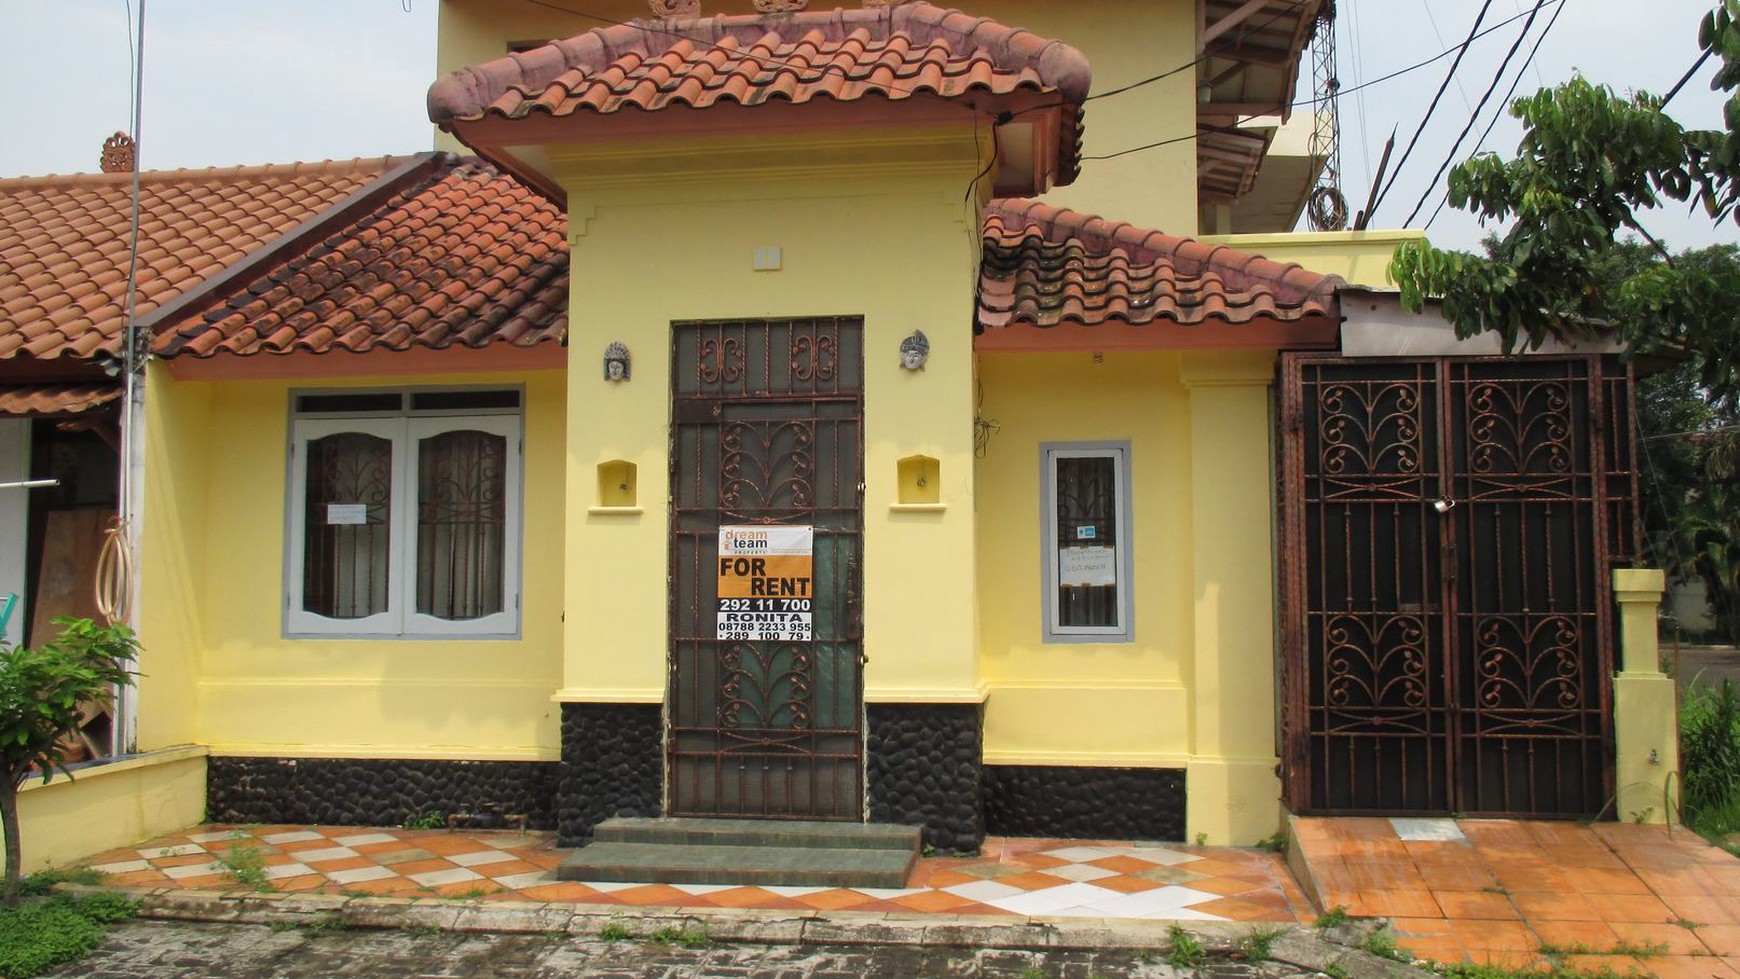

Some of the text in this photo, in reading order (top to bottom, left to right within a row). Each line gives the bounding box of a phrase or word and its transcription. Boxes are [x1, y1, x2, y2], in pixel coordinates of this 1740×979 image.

[726, 529, 768, 540] dream
[734, 538, 768, 548] team
[721, 558, 766, 576] FOR
[752, 577, 810, 596] RENT
[720, 599, 811, 611] 292 11 700
[726, 613, 803, 622] RONITA
[719, 622, 811, 631] 08788 2233 955
[726, 632, 804, 640] 289 100 79
